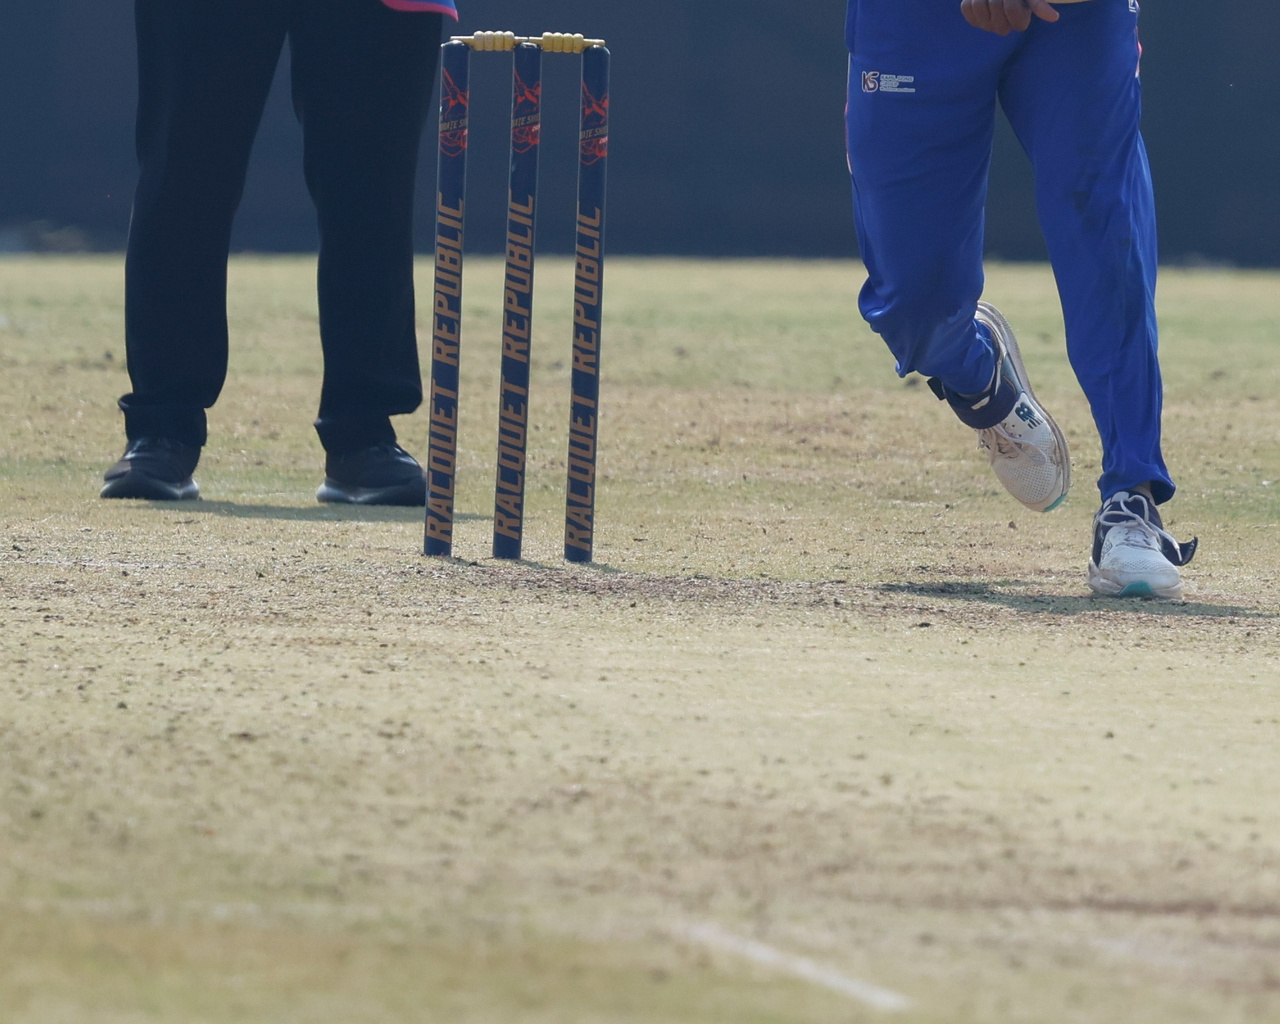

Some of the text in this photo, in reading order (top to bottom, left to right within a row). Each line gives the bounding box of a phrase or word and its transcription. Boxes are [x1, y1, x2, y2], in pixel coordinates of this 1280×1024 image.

[426, 192, 463, 543] RACQUET REPUBLIC
[495, 189, 534, 542] RACQUET REPUBLIC
[566, 201, 601, 552] RACQUET REPUBLIC
